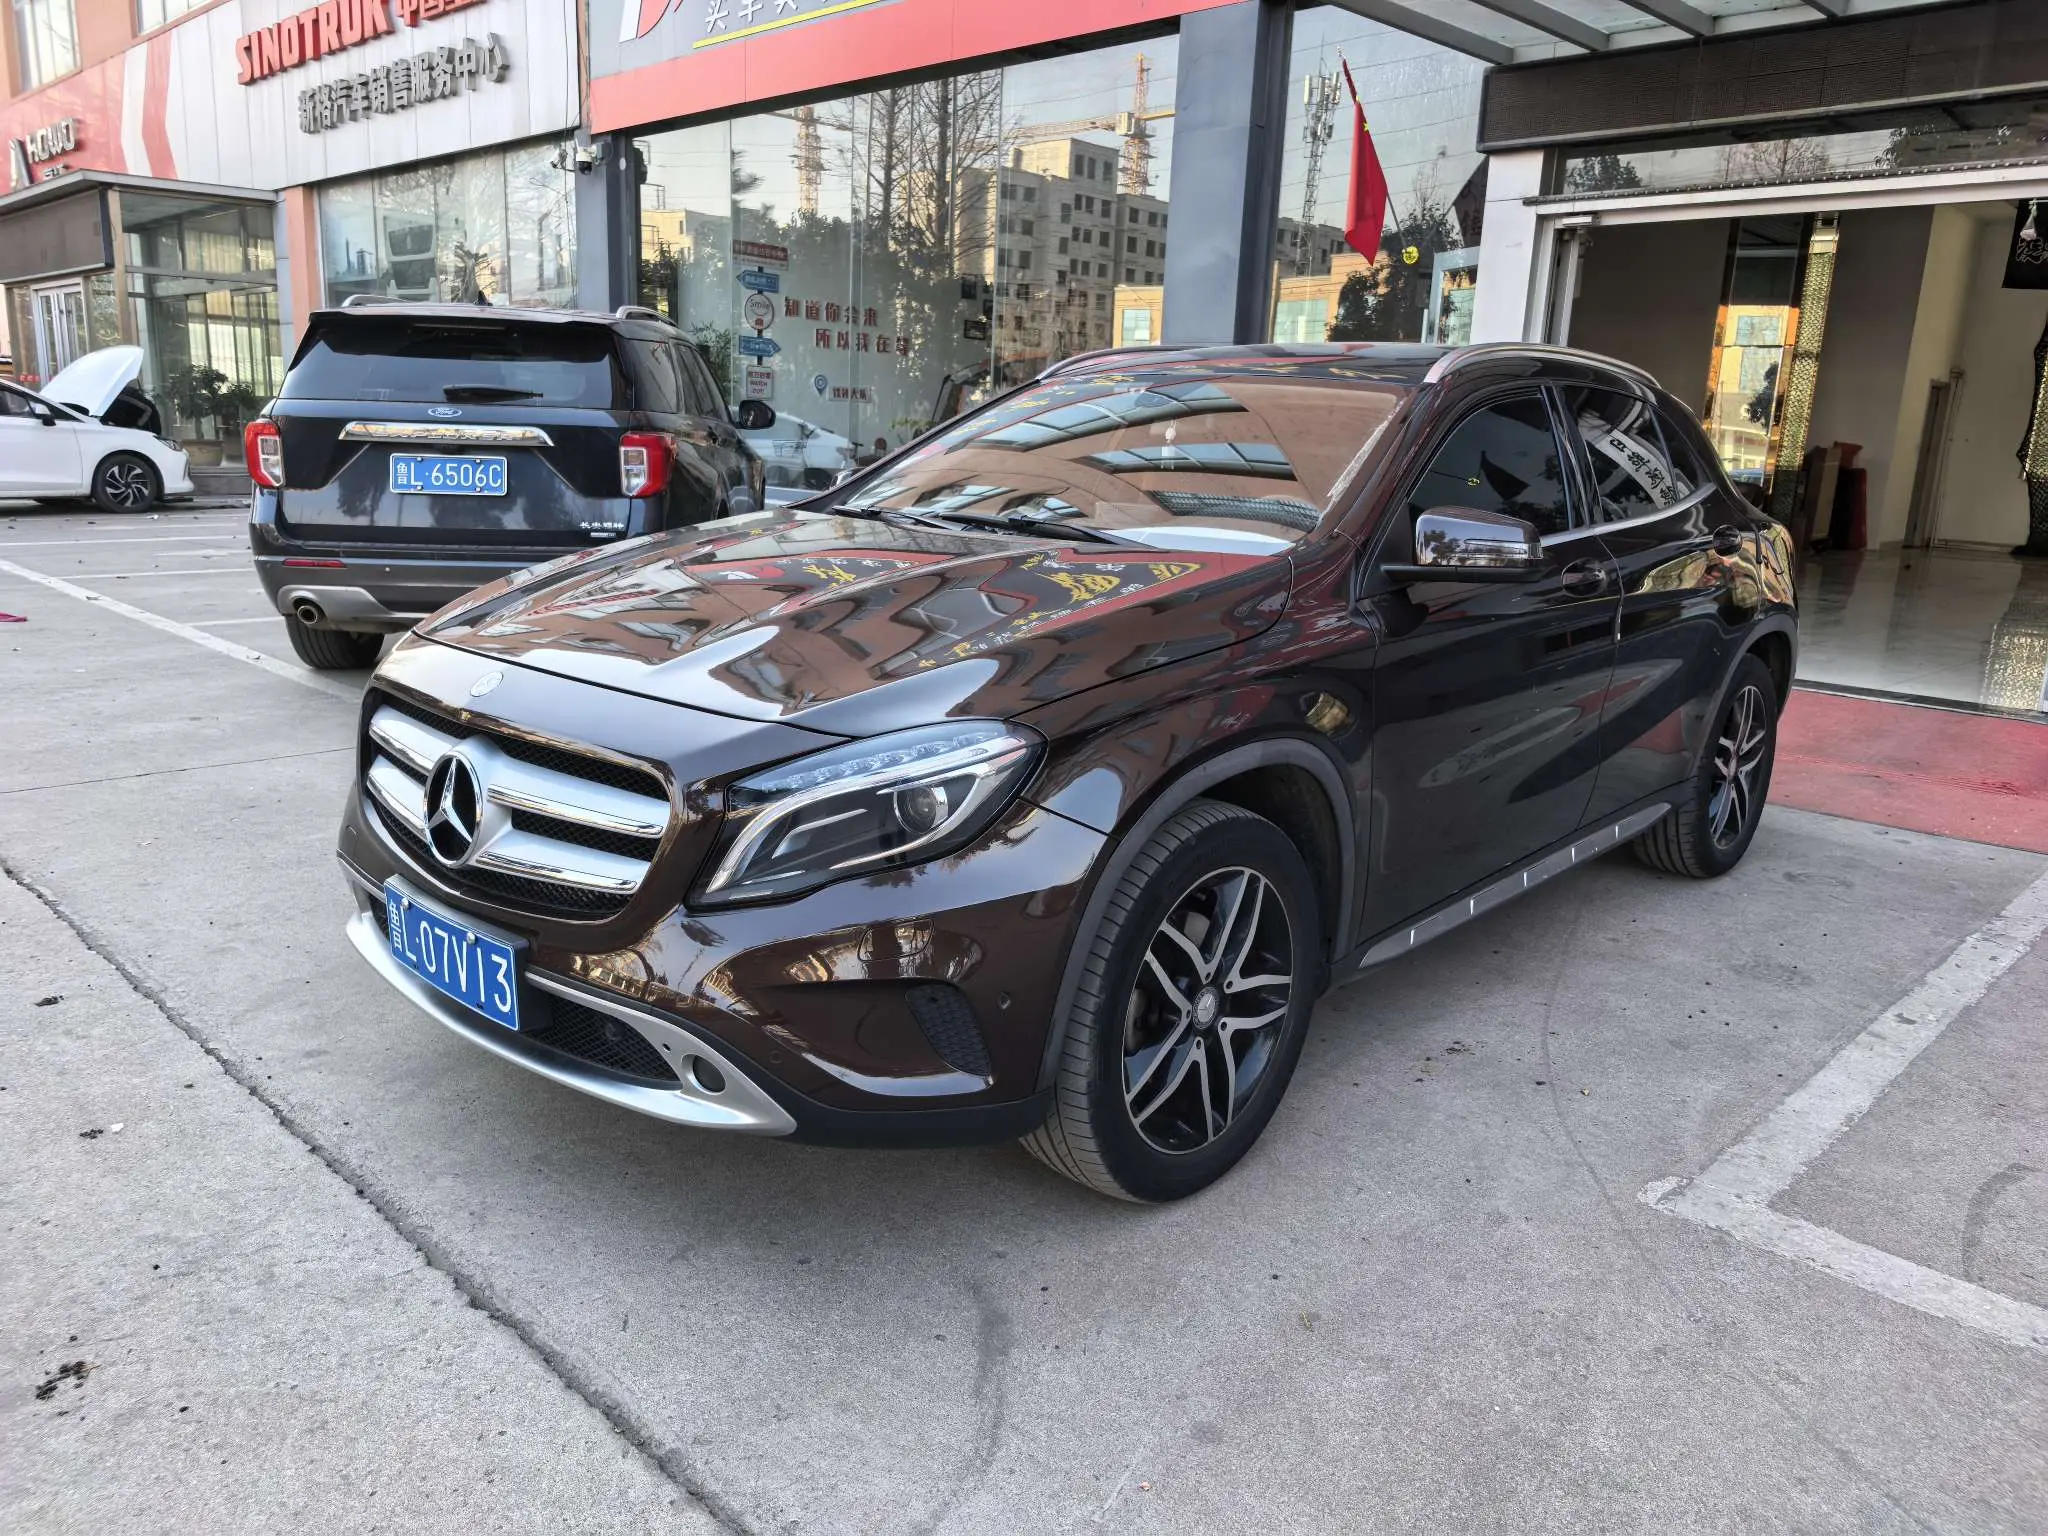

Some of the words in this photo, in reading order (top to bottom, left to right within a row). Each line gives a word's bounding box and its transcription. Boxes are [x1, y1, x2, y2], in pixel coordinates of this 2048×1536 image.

[235, 0, 393, 85] SINOTRUK
[784, 296, 878, 327] 知道你会来
